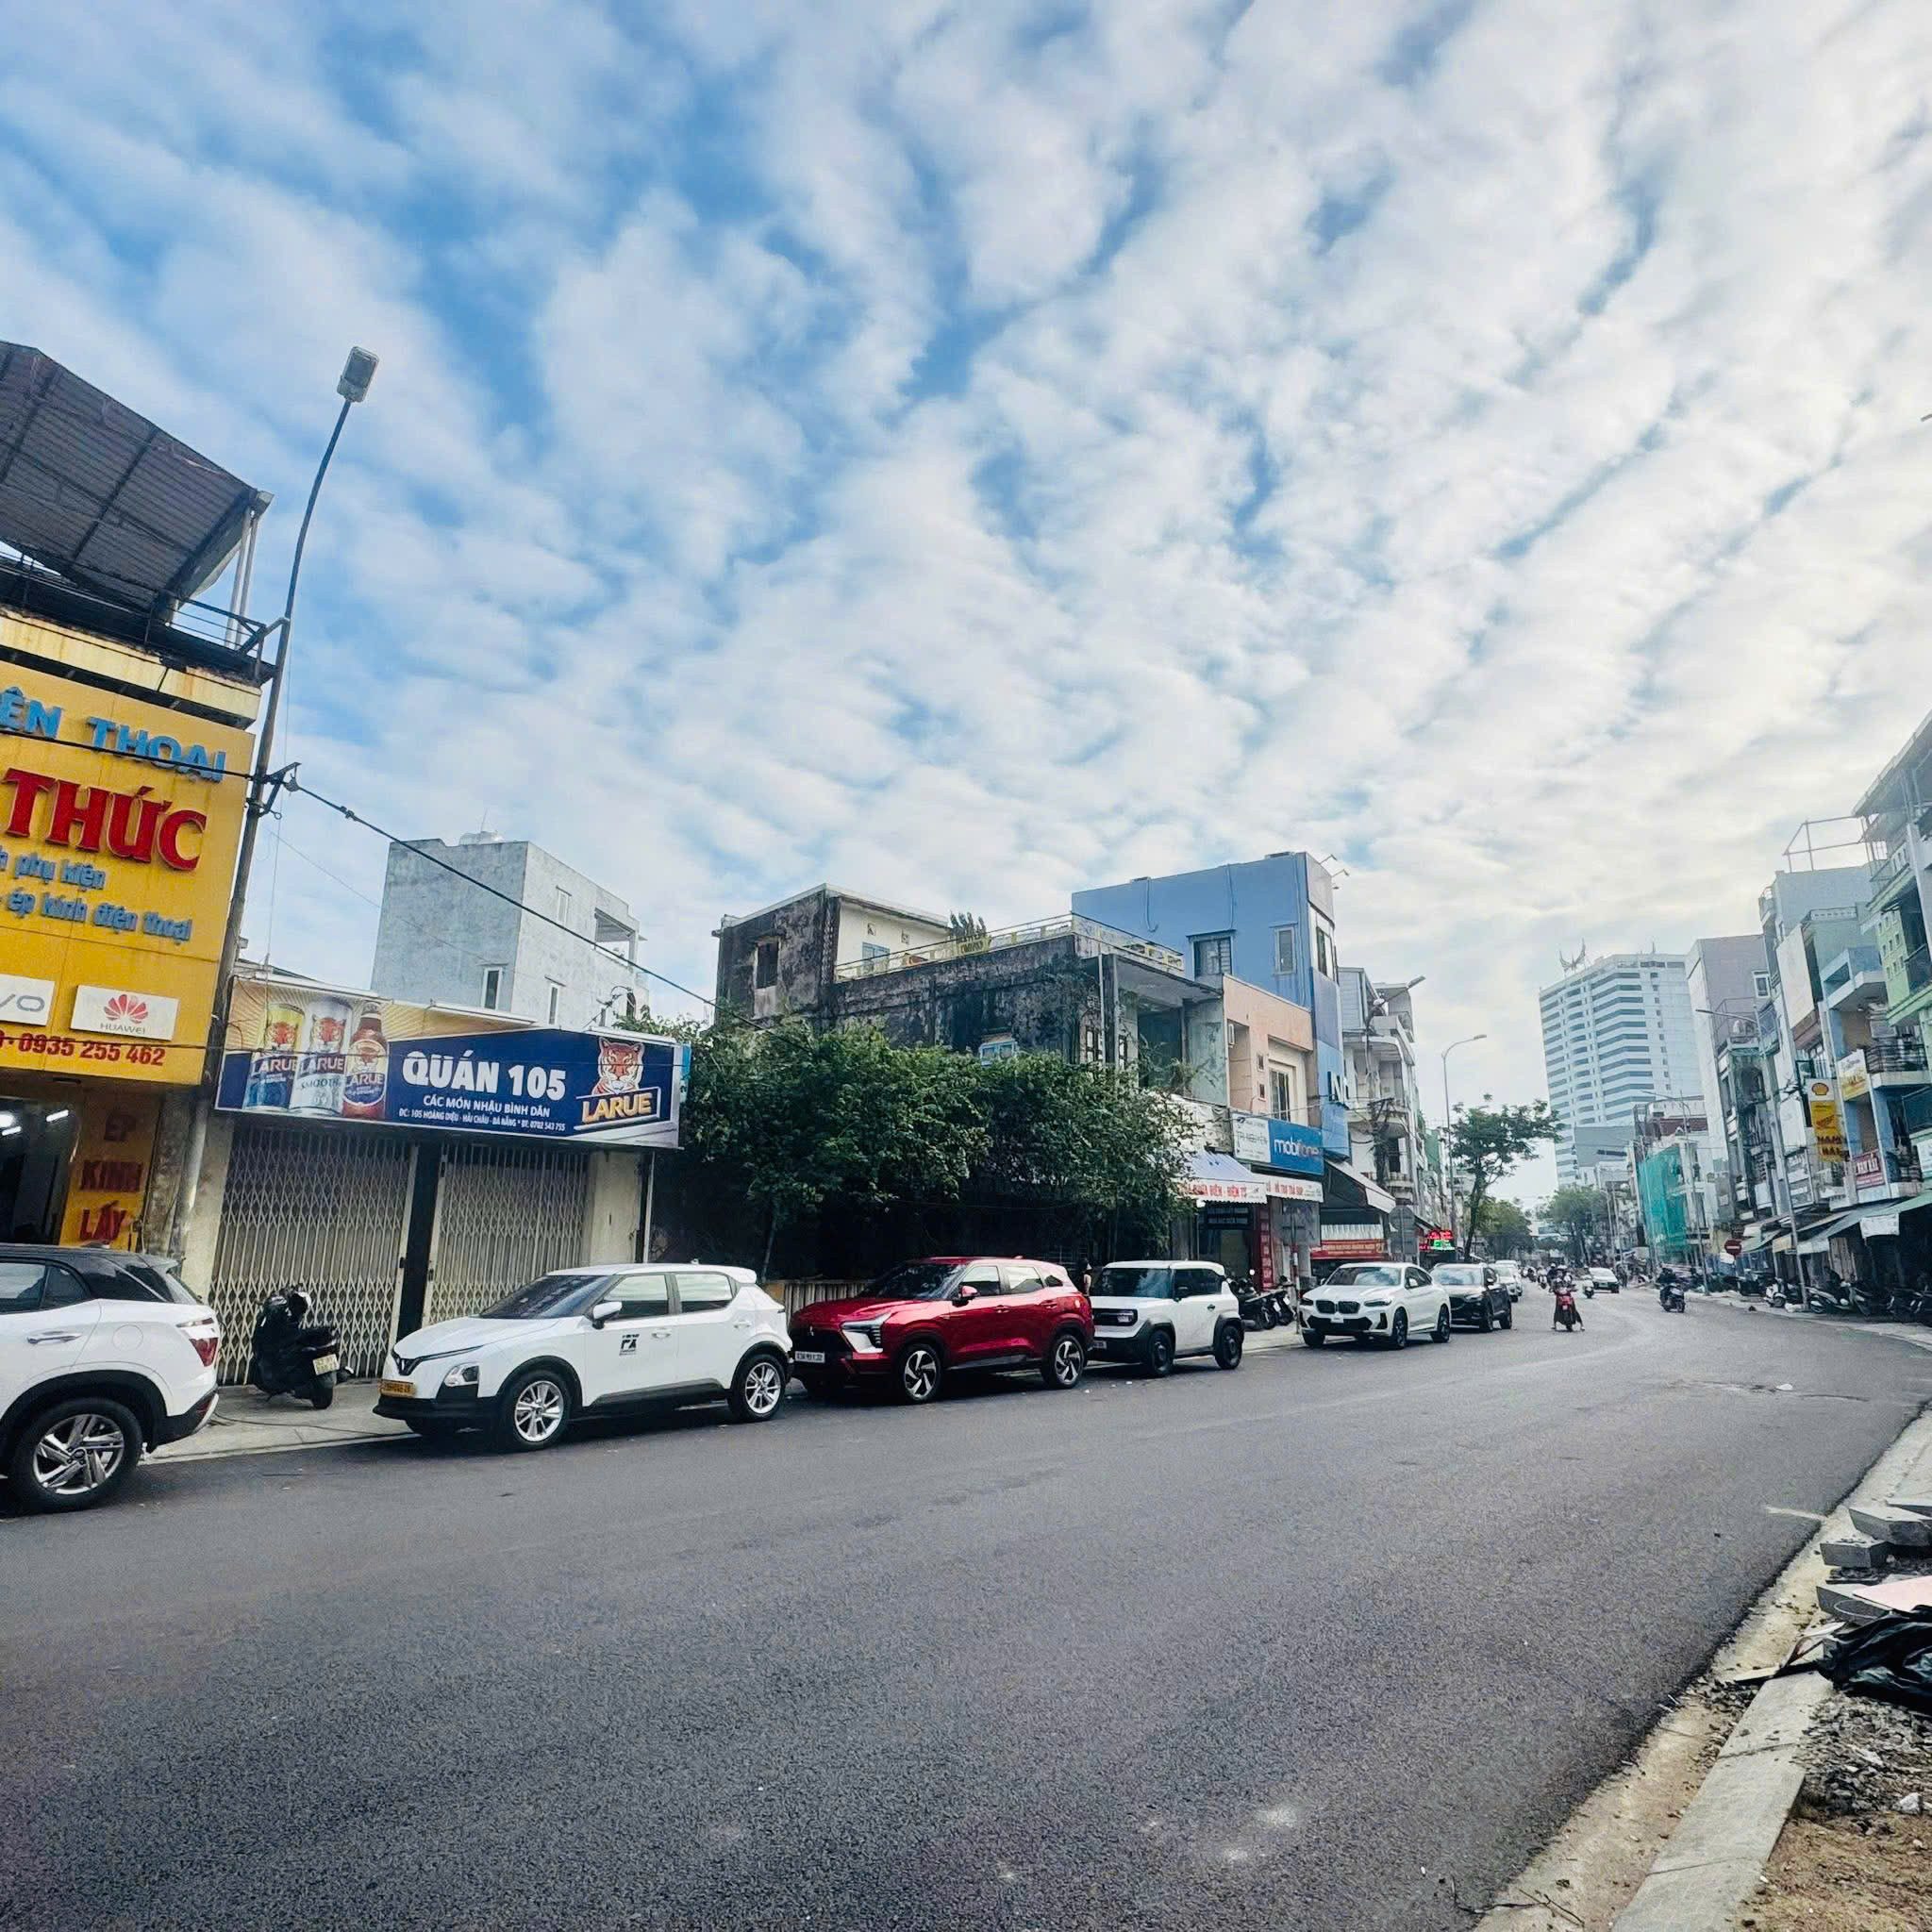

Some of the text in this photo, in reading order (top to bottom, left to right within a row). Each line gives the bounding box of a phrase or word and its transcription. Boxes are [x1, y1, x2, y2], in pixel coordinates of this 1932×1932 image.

[2, 767, 208, 872] THỨC
[100, 1023, 145, 1035] HUAWEI
[18, 1033, 75, 1057] 0935
[80, 1041, 122, 1062] 255
[125, 1045, 166, 1066] 462
[300, 1057, 344, 1075] LARUE
[402, 1050, 566, 1101] QUÁN 105
[424, 1093, 550, 1118] CÁC MÓN NHẬU BÌNH DÂN
[581, 1092, 653, 1124] LARUE
